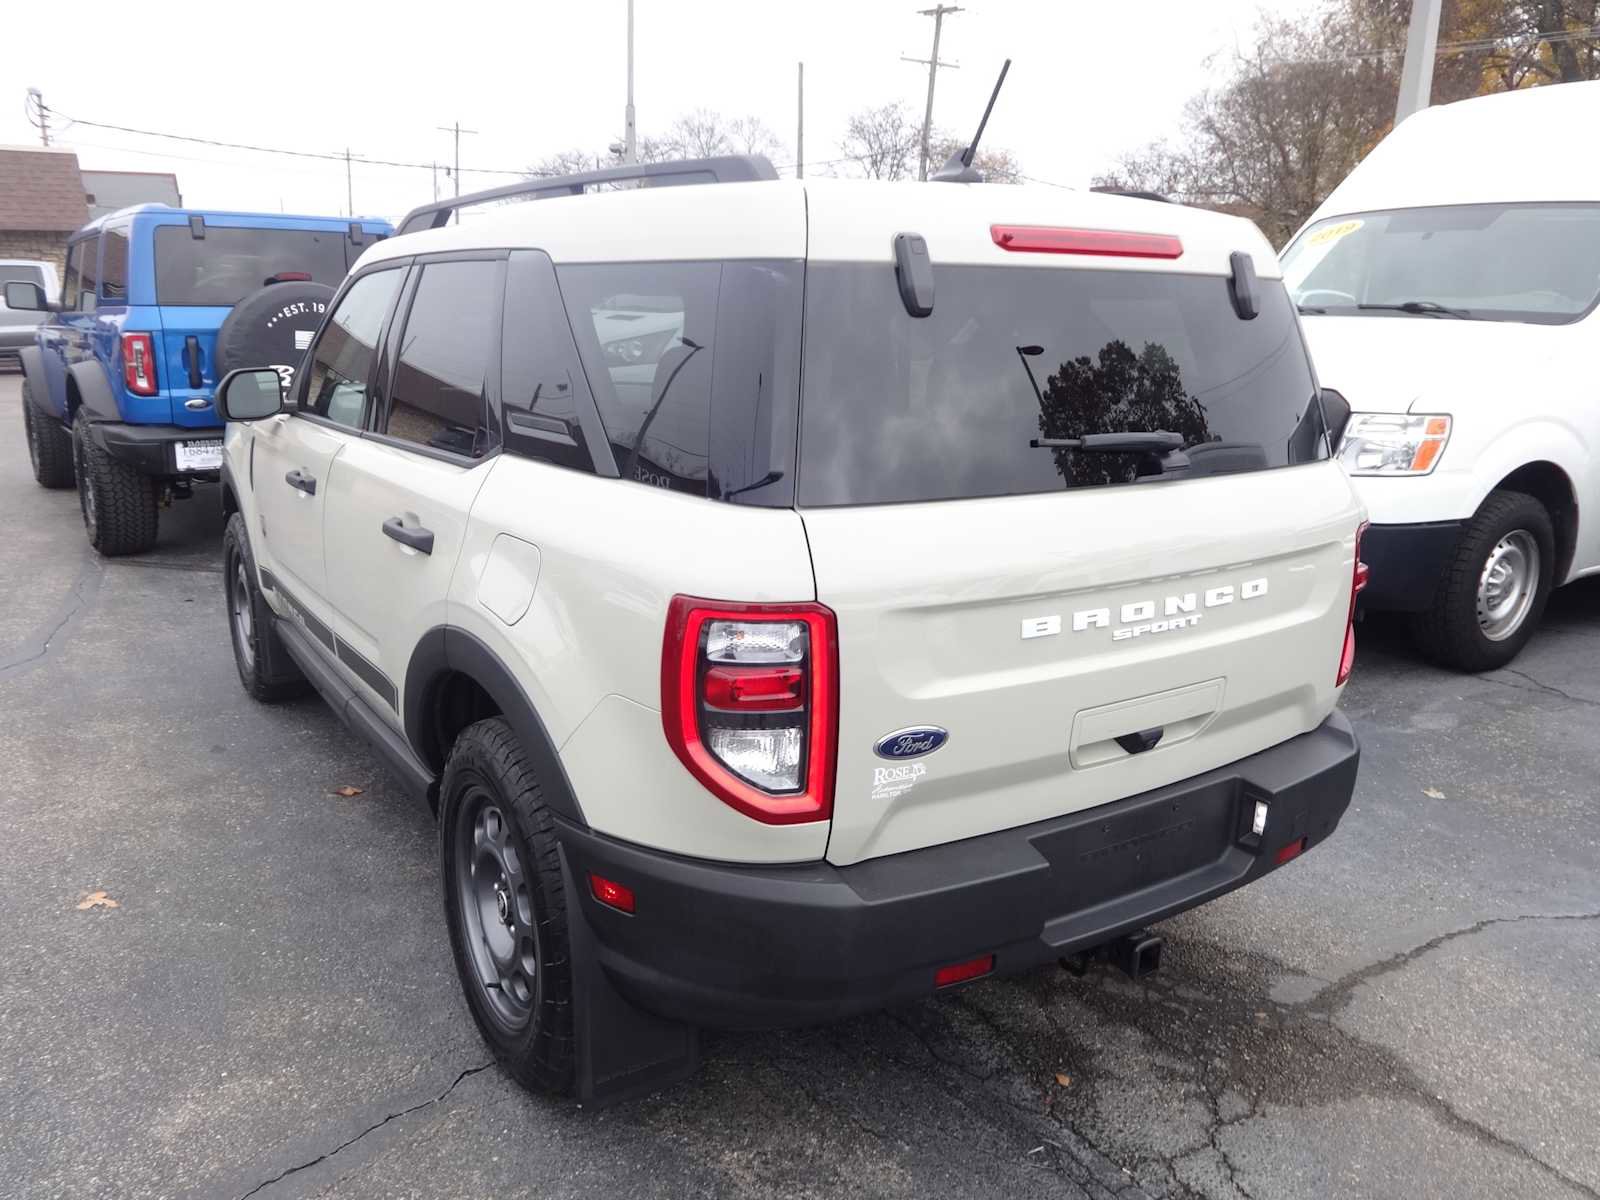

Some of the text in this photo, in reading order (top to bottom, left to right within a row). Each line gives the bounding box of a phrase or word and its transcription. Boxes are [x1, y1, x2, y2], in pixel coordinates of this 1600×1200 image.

[283, 302, 326, 318] EST. 19
[1021, 577, 1269, 640] BRONCO
[1112, 613, 1203, 641] SPORT
[872, 766, 911, 786] ROSE
